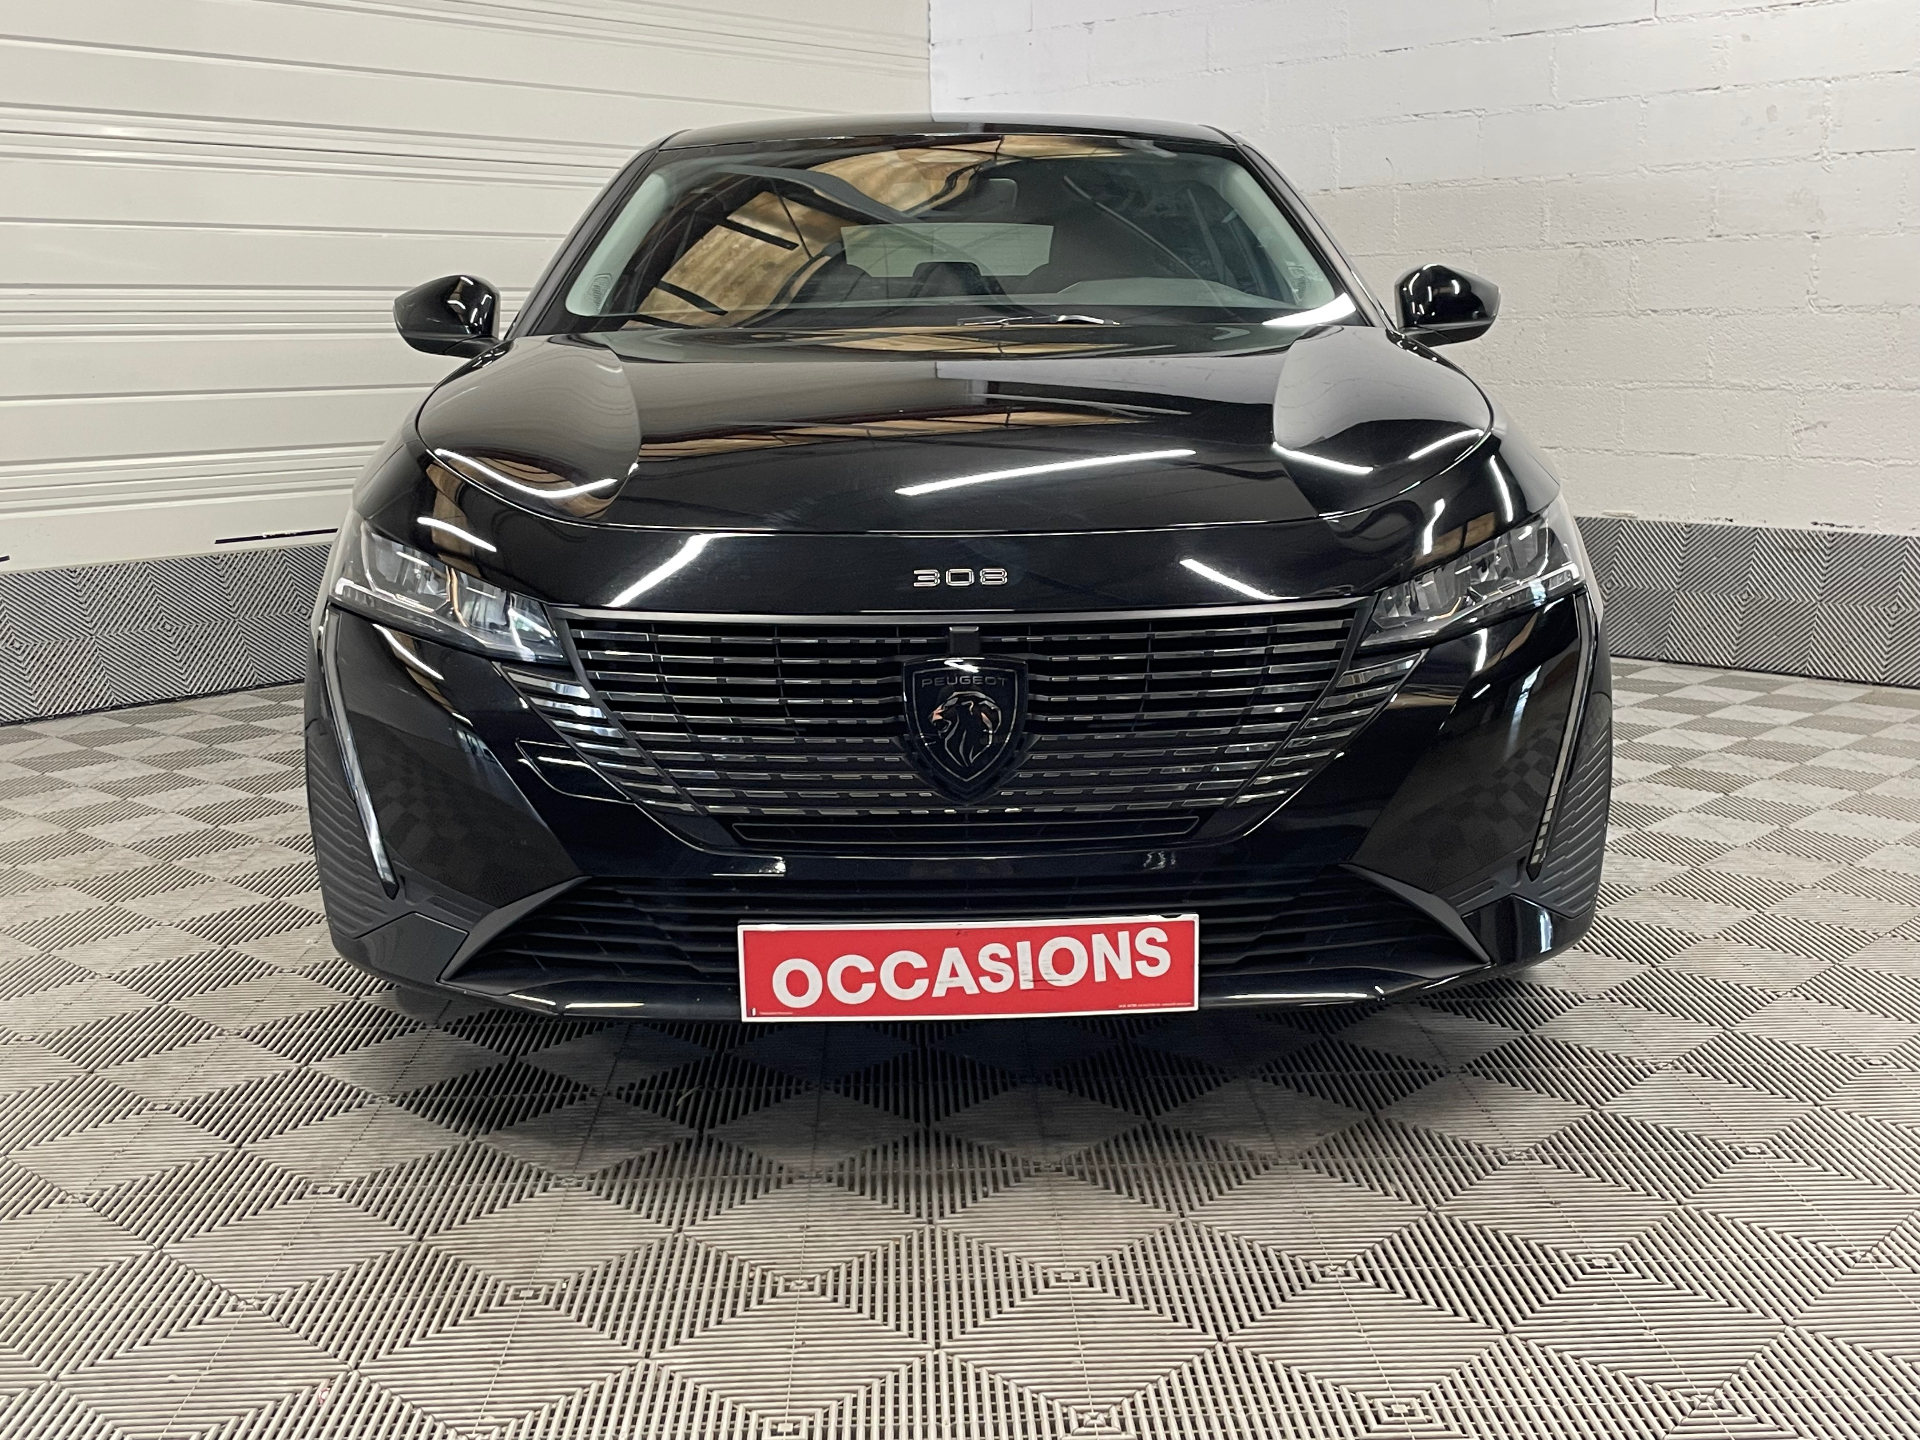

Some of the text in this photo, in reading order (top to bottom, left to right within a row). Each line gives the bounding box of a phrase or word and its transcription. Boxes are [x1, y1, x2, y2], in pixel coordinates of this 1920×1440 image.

[913, 568, 1008, 587] 308
[921, 675, 1008, 688] PEUGEOT
[772, 927, 1171, 1008] OCCASIONS
